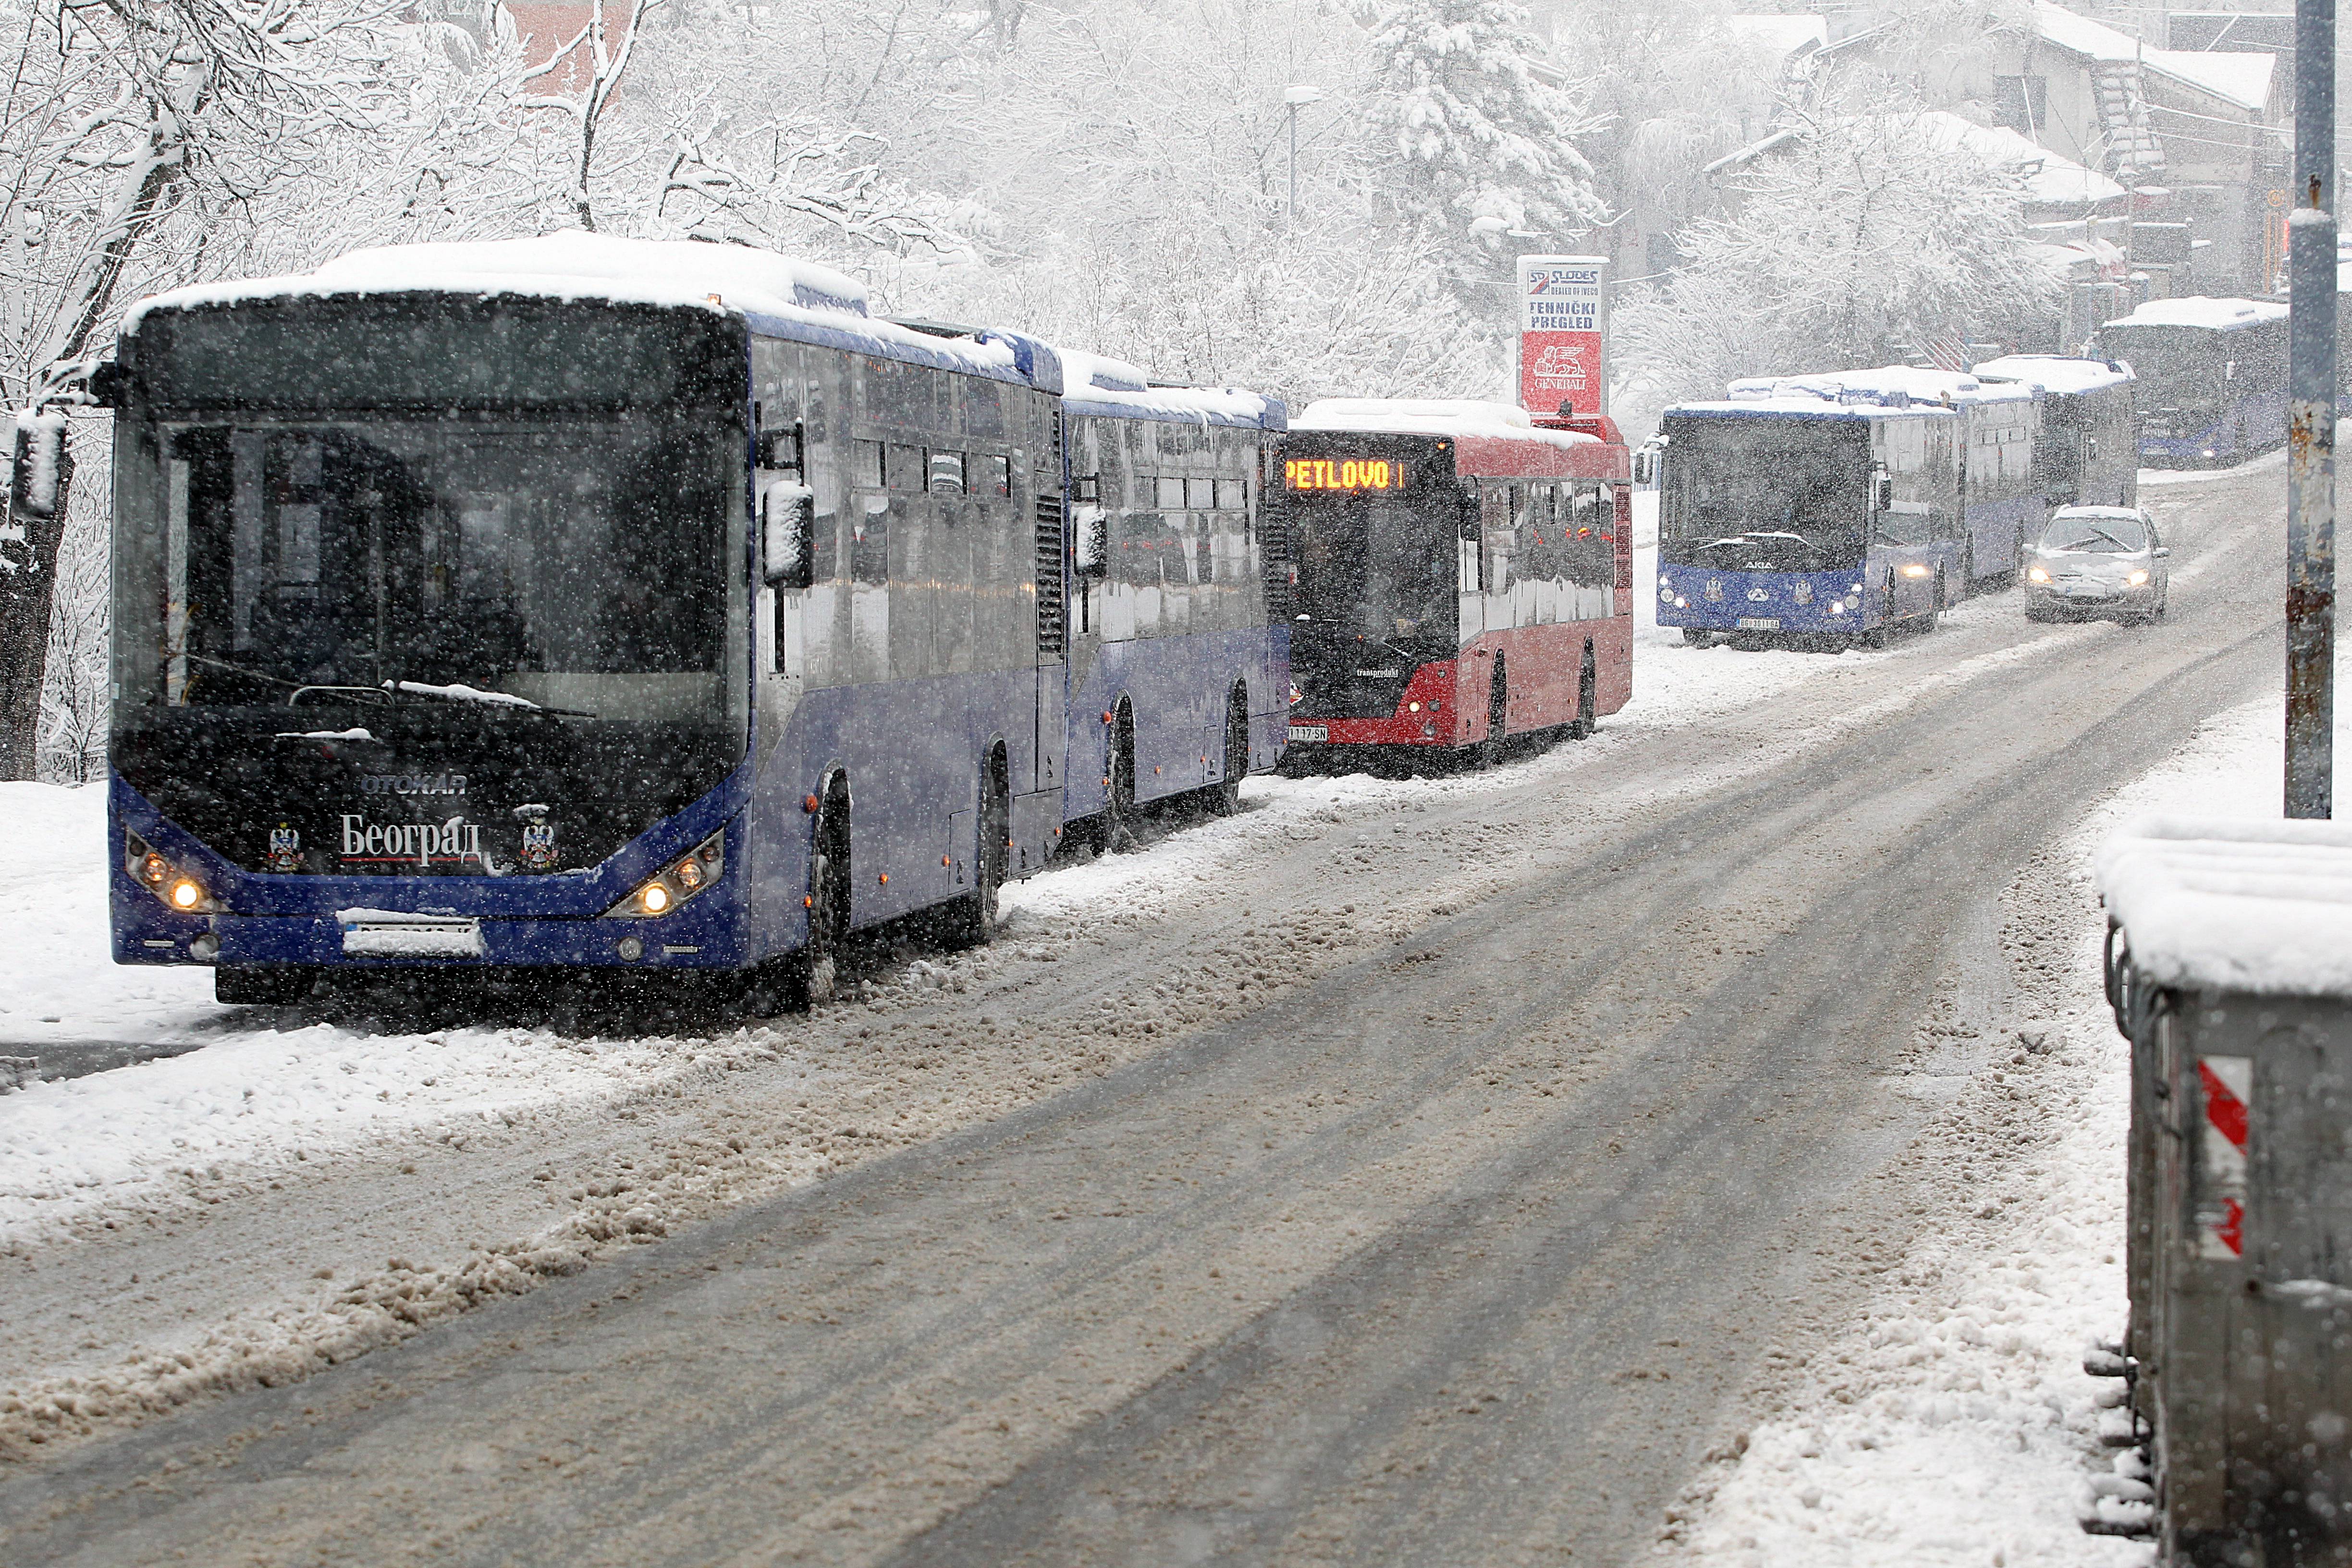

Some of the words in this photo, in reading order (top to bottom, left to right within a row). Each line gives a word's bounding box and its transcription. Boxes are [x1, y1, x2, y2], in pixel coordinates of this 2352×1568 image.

[1551, 270, 1598, 284] SLODES
[1551, 287, 1572, 295] DEALER
[1573, 287, 1580, 295] OF
[1581, 287, 1598, 296] IVECO
[1530, 300, 1595, 315] TEHNIČKI
[1531, 316, 1593, 329] PREGLED
[1534, 378, 1586, 390] GENERALI
[1745, 561, 1774, 569] AKIA
[1357, 667, 1398, 678] transprodukt
[361, 775, 467, 795] OTOKAR
[339, 814, 481, 867] Београд
